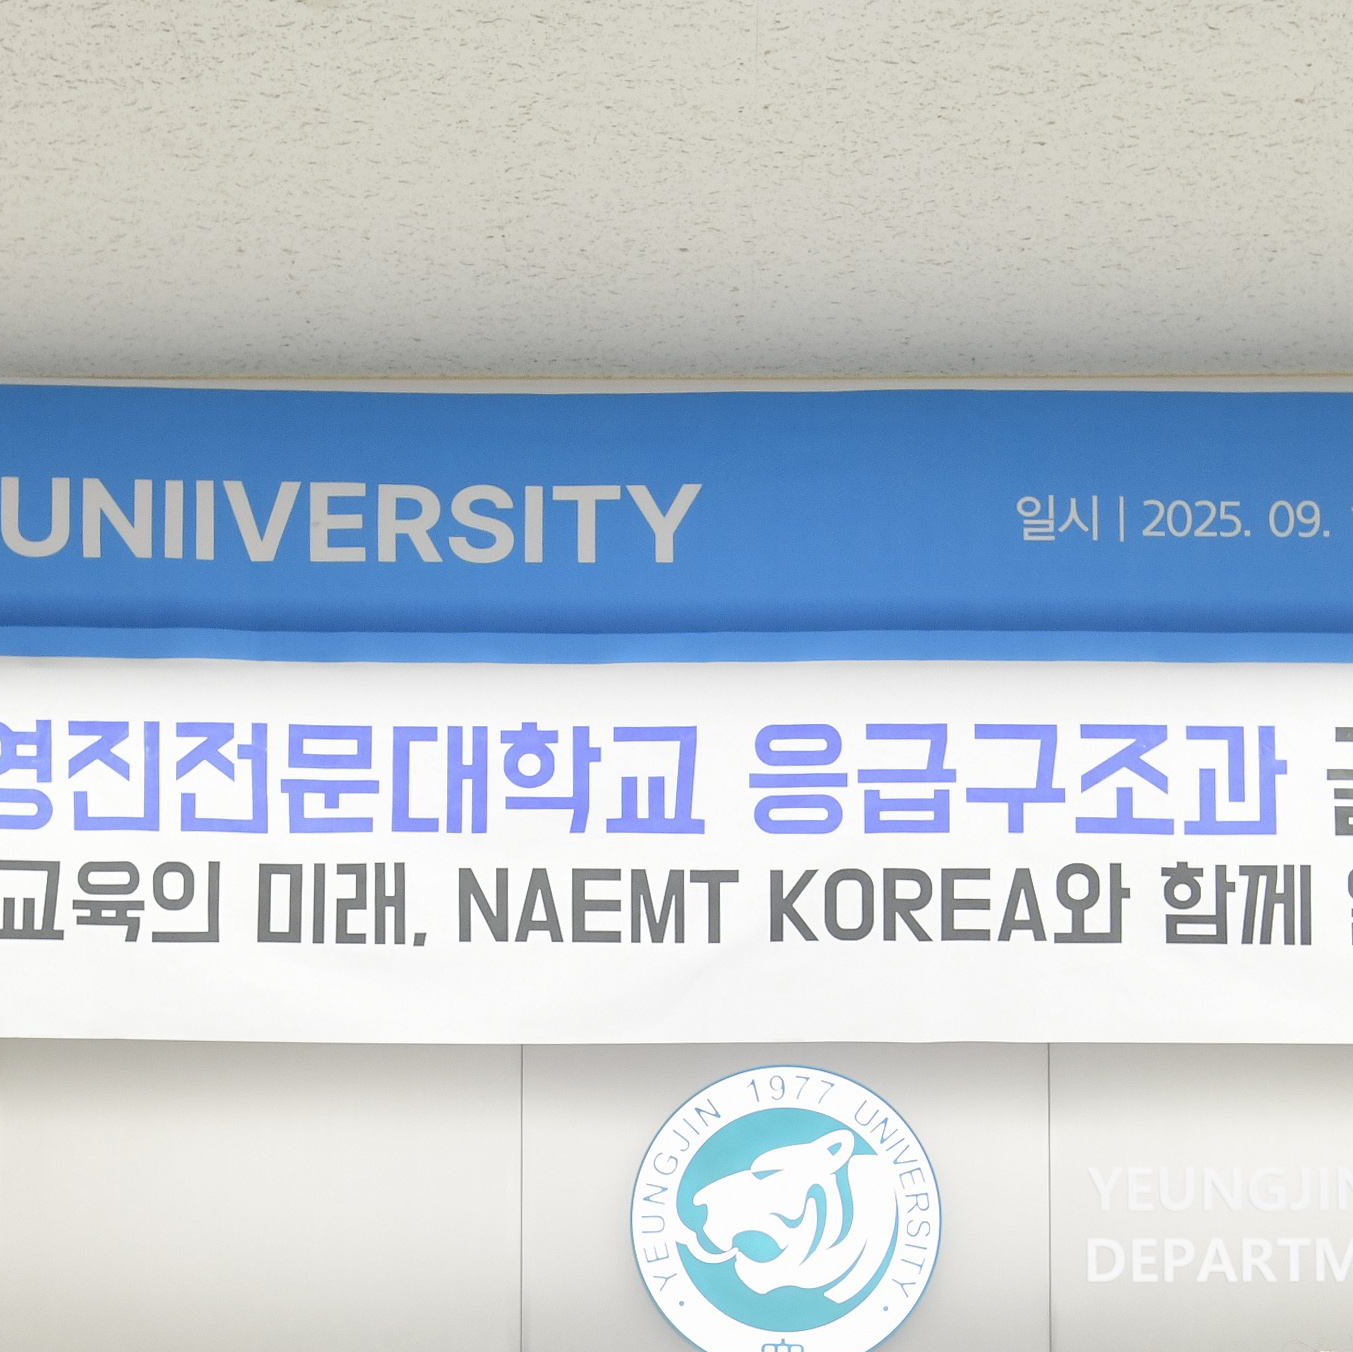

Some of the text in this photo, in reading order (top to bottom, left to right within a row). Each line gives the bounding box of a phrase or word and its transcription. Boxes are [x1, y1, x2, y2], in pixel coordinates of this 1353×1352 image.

[0, 477, 703, 564] UNIIVERSITY
[1015, 493, 1100, 542] 일시
[1141, 499, 1252, 539] 2025.
[1268, 500, 1330, 539] 09.
[748, 723, 1289, 836] 응급구조과
[255, 862, 428, 947] 미래,
[458, 867, 741, 944] NAEMT
[768, 862, 1132, 944] KOREA와
[1160, 861, 1313, 946] 함께
[641, 1074, 932, 1299] YEUNGJIN 1977 UNIVERSITY
